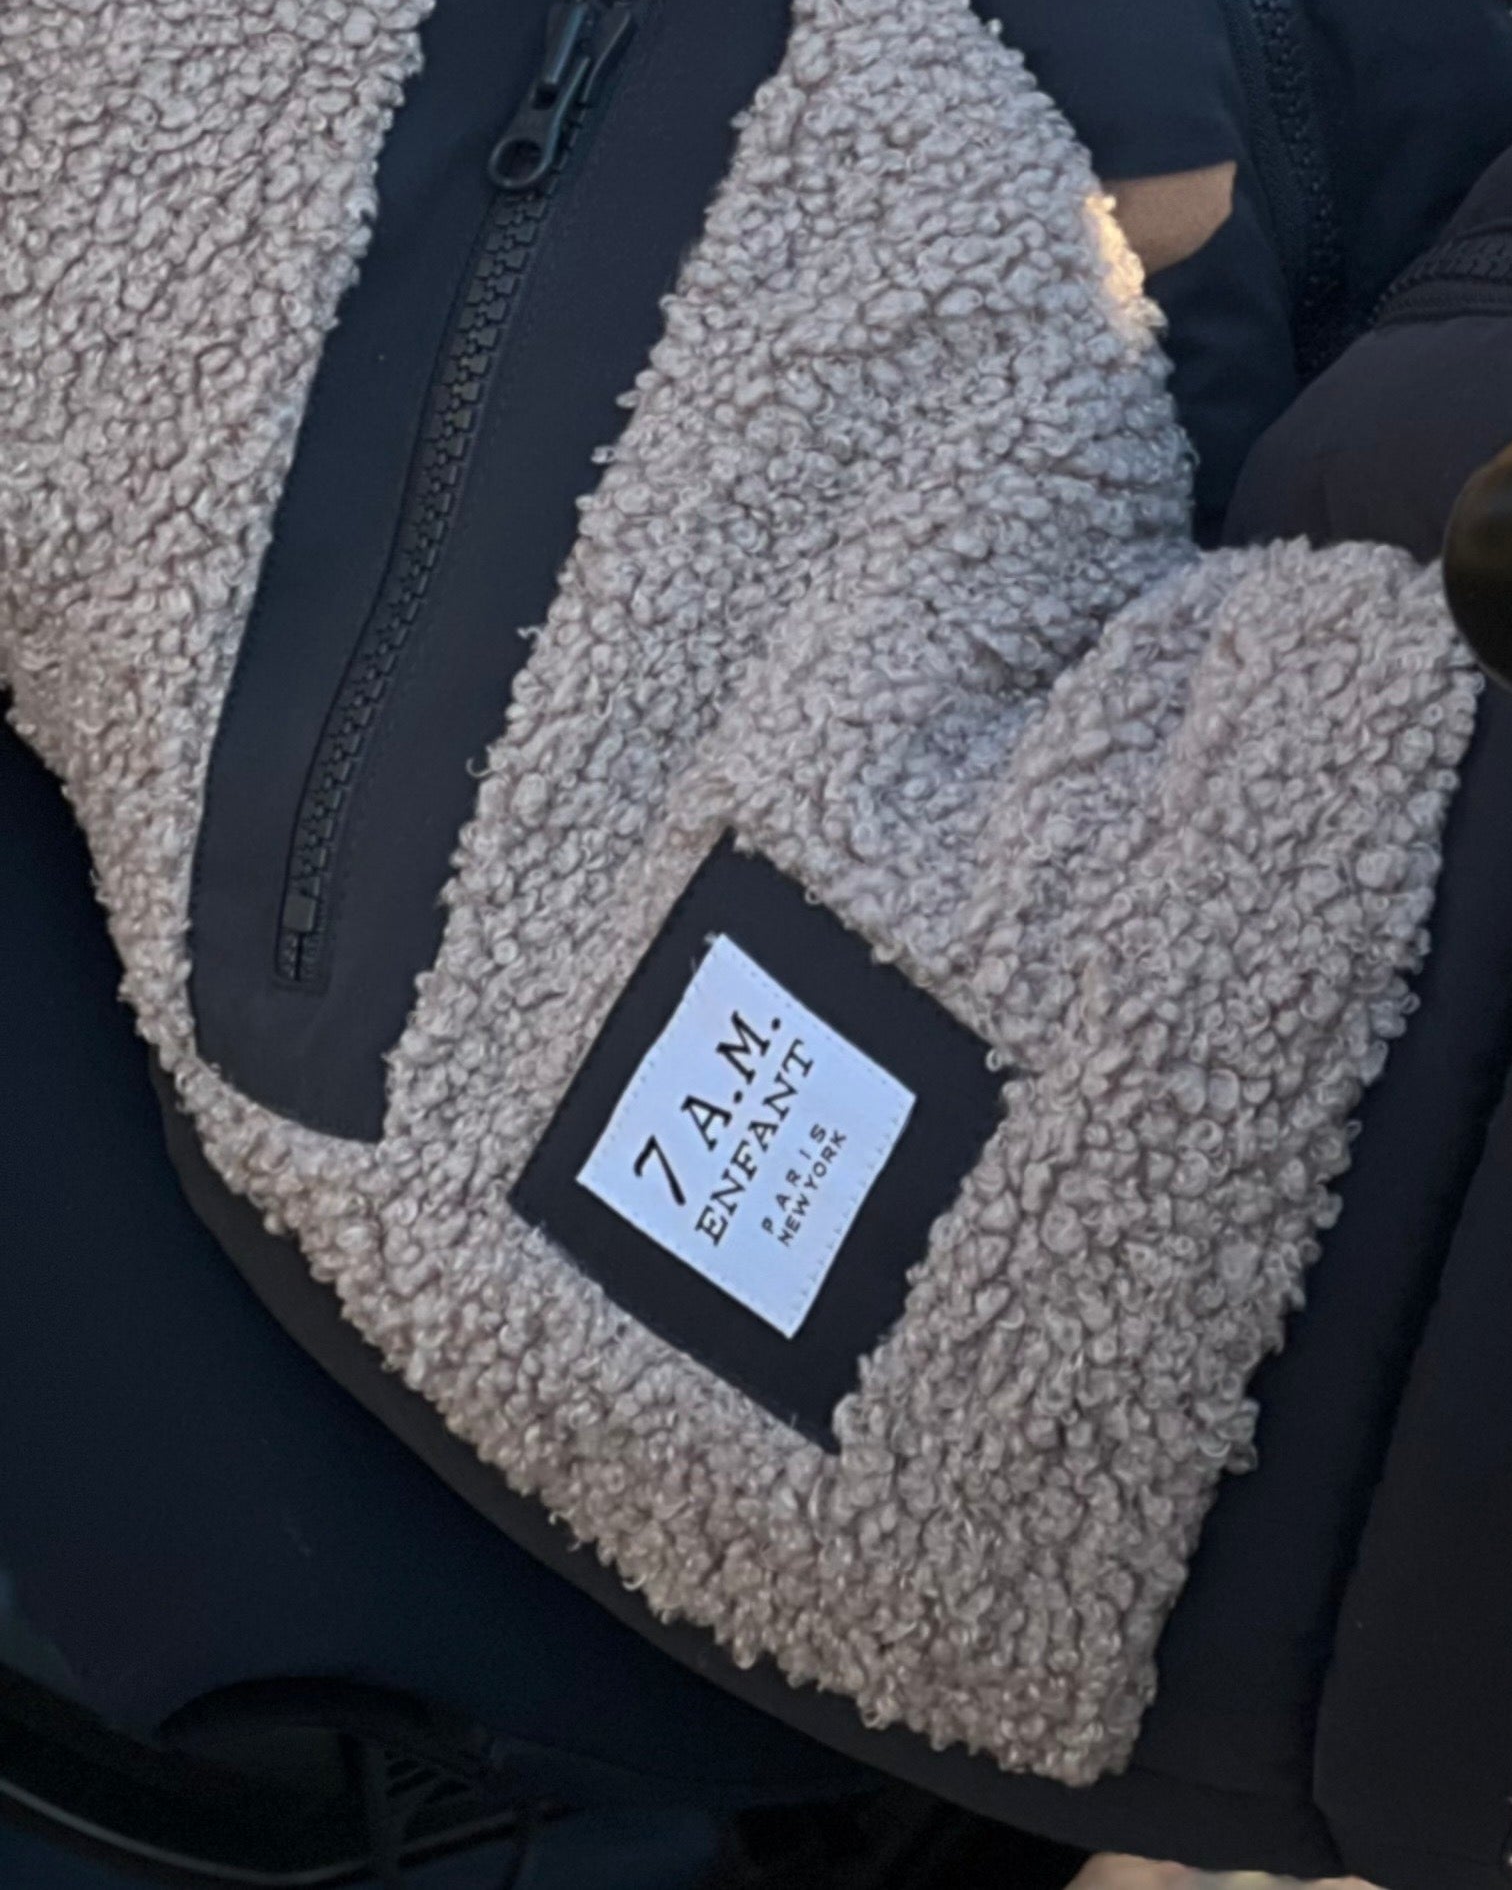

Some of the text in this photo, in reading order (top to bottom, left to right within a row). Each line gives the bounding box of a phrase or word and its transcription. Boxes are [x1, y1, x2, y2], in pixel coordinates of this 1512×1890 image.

[633, 1010, 782, 1207] 7 A.M.
[694, 1037, 814, 1247] ENFANT
[761, 1122, 827, 1235] PARIS
